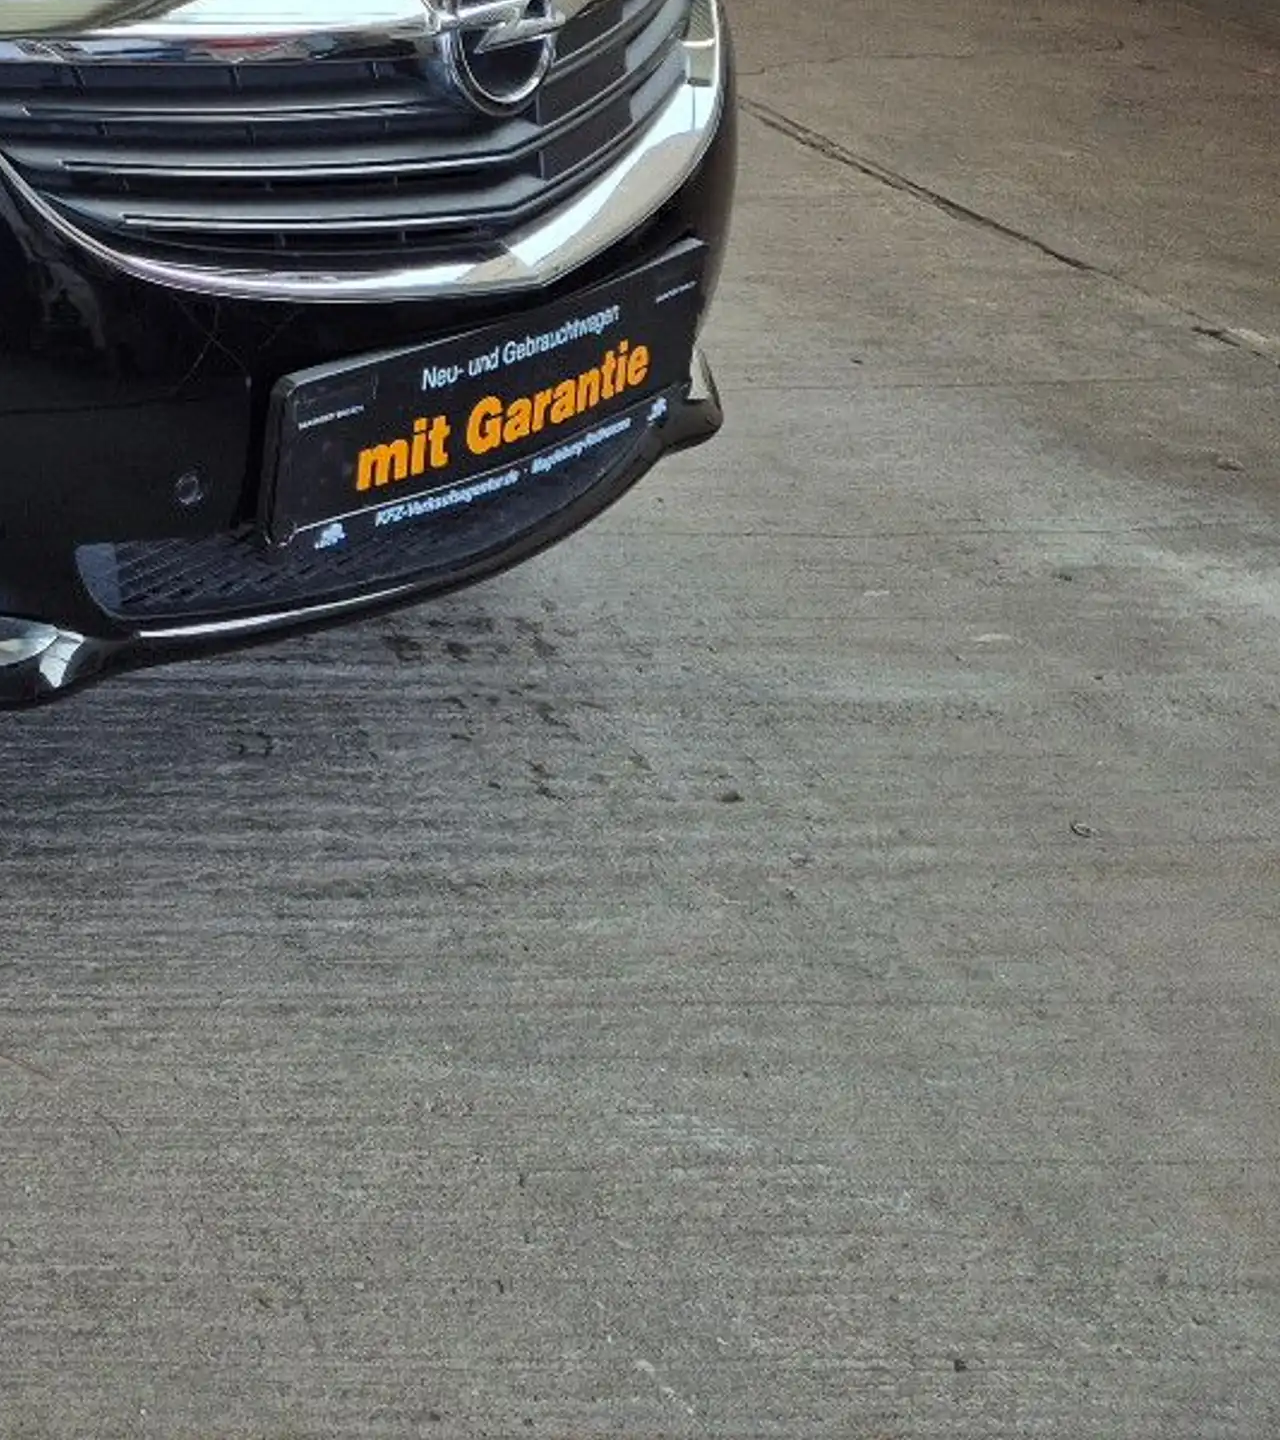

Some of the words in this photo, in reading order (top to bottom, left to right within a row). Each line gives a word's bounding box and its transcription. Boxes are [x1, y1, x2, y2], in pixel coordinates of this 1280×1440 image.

[421, 364, 465, 392] Neu-
[467, 347, 501, 377] und
[502, 304, 621, 365] Gebrauchtwagen
[356, 415, 451, 492] mit
[466, 339, 651, 455] Garantie
